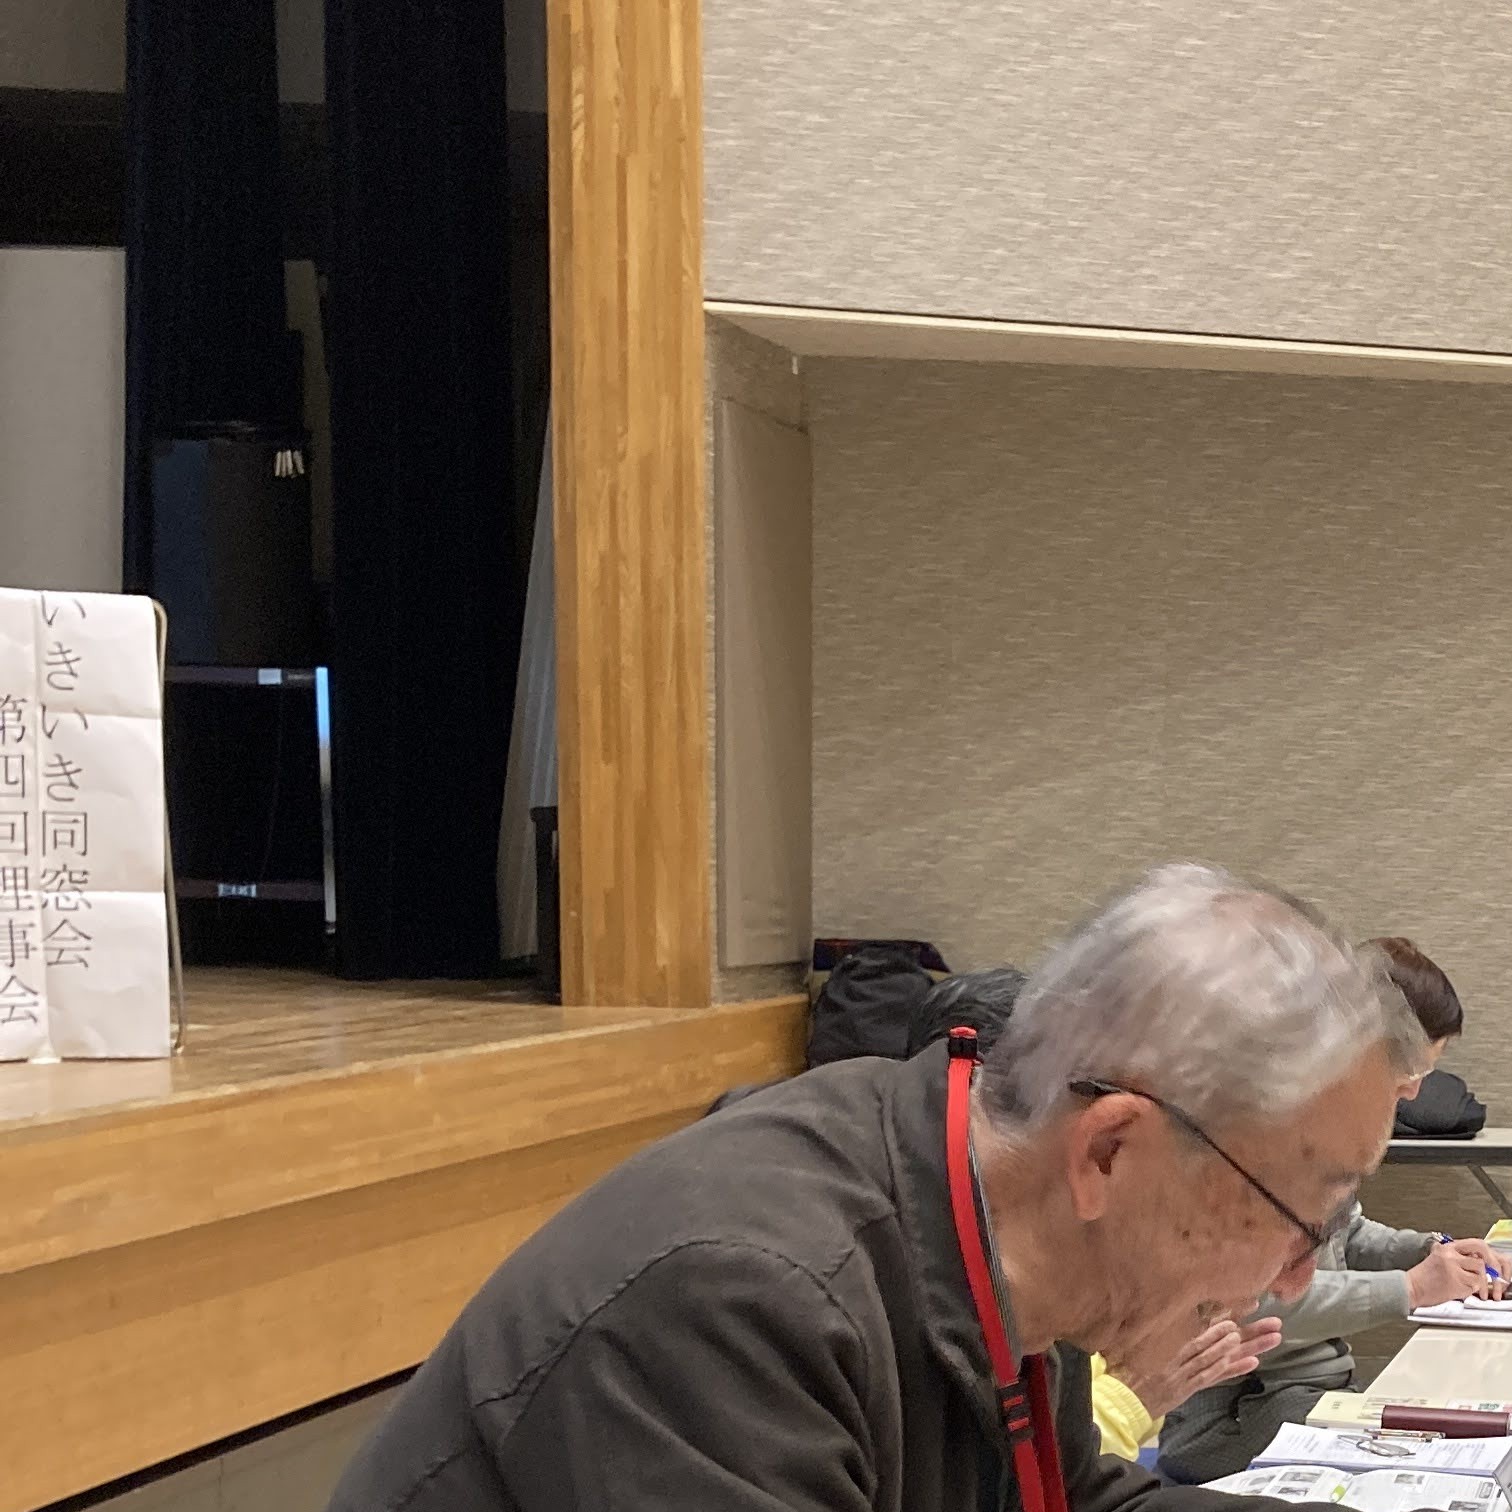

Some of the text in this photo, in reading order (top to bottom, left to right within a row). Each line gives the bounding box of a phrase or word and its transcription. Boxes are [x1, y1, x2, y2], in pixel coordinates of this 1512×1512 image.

[0, 693, 40, 1025] 第四回理事会
[39, 591, 93, 970] いきいき同窓会
